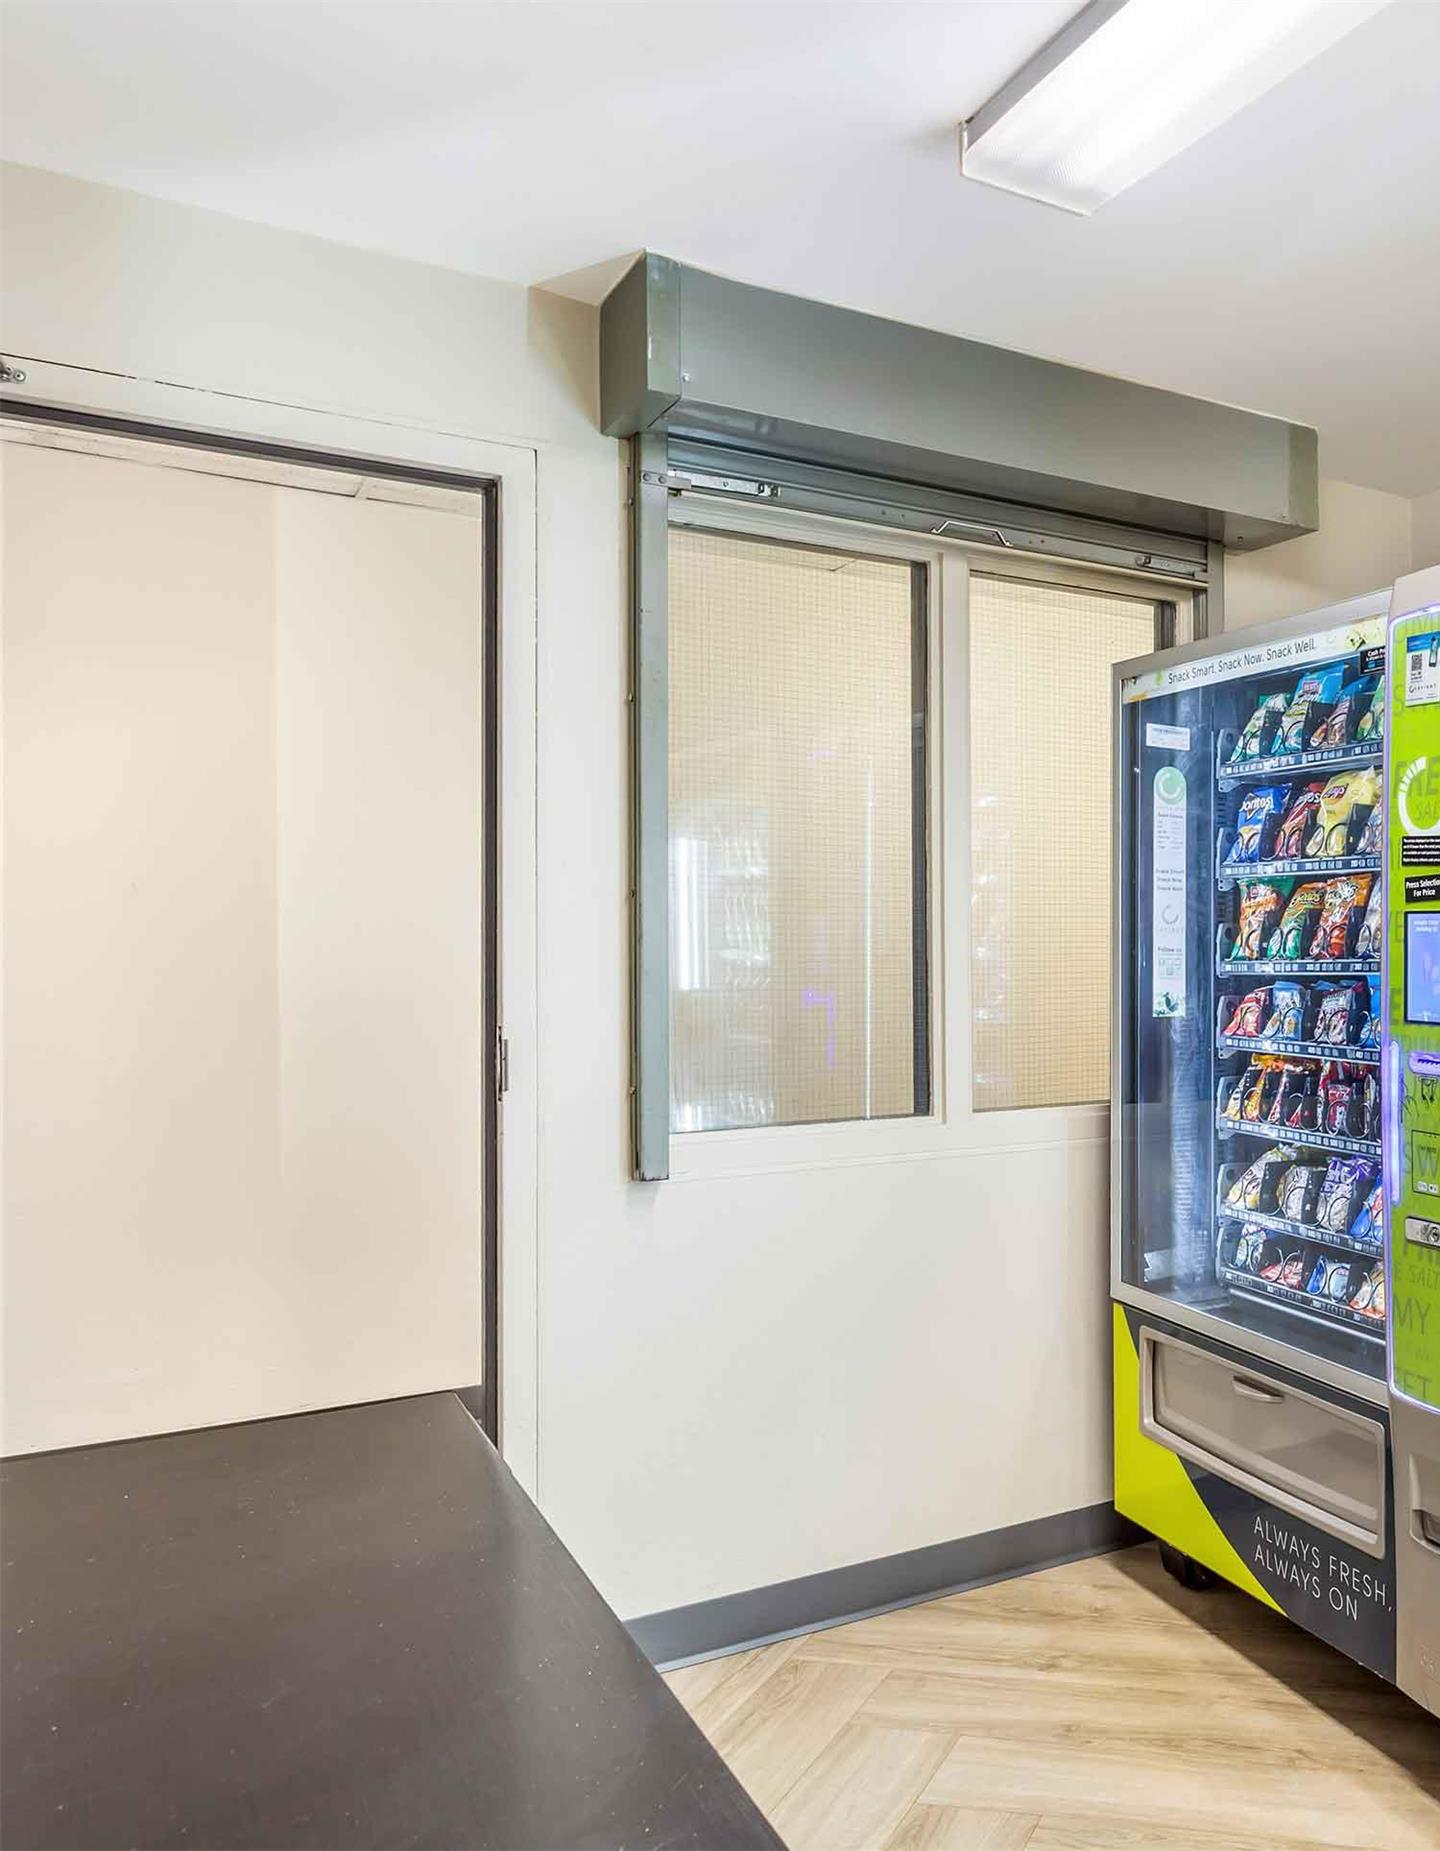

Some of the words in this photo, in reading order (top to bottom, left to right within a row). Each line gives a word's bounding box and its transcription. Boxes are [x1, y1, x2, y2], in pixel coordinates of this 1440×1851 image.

[1168, 672, 1189, 684] Snack
[1218, 658, 1242, 673] Snack
[1244, 653, 1265, 666] Now.
[1266, 647, 1292, 661] Snack
[1254, 1516, 1320, 1569] ALWAYS
[1328, 1555, 1392, 1612] FRESH,
[1254, 1544, 1321, 1598] ALWAYS
[1329, 1586, 1358, 1621] ON
